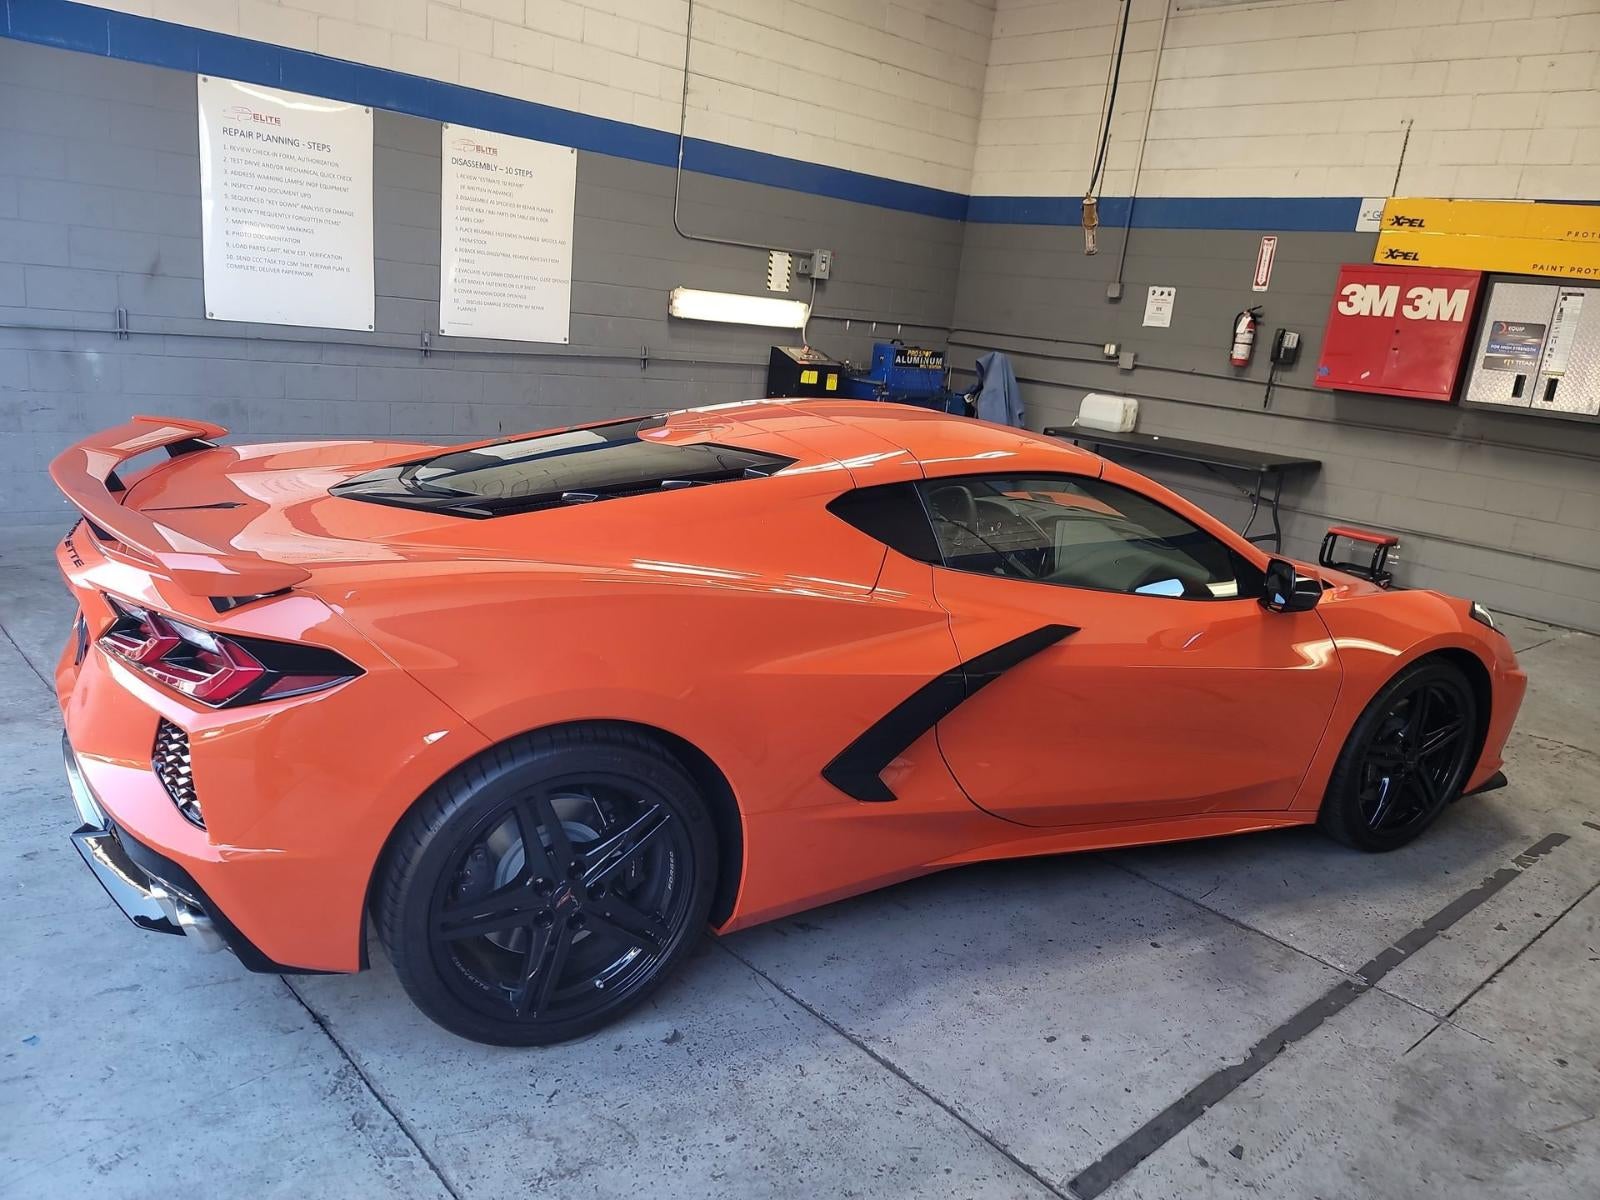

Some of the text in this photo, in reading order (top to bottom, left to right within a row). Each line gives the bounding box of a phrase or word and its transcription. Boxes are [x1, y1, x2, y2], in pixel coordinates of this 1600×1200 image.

[253, 112, 280, 124] ELITE
[222, 126, 254, 140] REPAIR
[256, 132, 300, 148] PLANNING
[307, 142, 332, 152] STEPS
[476, 145, 498, 156] ELITE
[252, 148, 278, 157] CHECK-IN
[298, 156, 339, 168] AUTHORIZATION
[285, 166, 319, 176] MECHANICAL
[451, 157, 498, 172] DISASSEMBLY
[514, 168, 533, 178] STEPS
[231, 170, 255, 178] ADDRESS
[257, 174, 283, 182] WARNING
[320, 184, 349, 192] EQUIPMENT
[301, 204, 324, 212] ANALYSIS
[332, 208, 354, 216] DAMAGE
[292, 216, 323, 224] FORGOTTEN
[1390, 216, 1425, 228] XPEL
[286, 226, 314, 234] MARKINGS
[1566, 231, 1600, 239] PROT
[252, 233, 301, 243] DOCUMENTATION
[309, 252, 342, 261] VERIFICATION
[1384, 248, 1420, 261] XPEL
[1532, 263, 1564, 272] PAINT
[1337, 283, 1470, 322] 3M 3M
[895, 355, 943, 365] ALUMINUM
